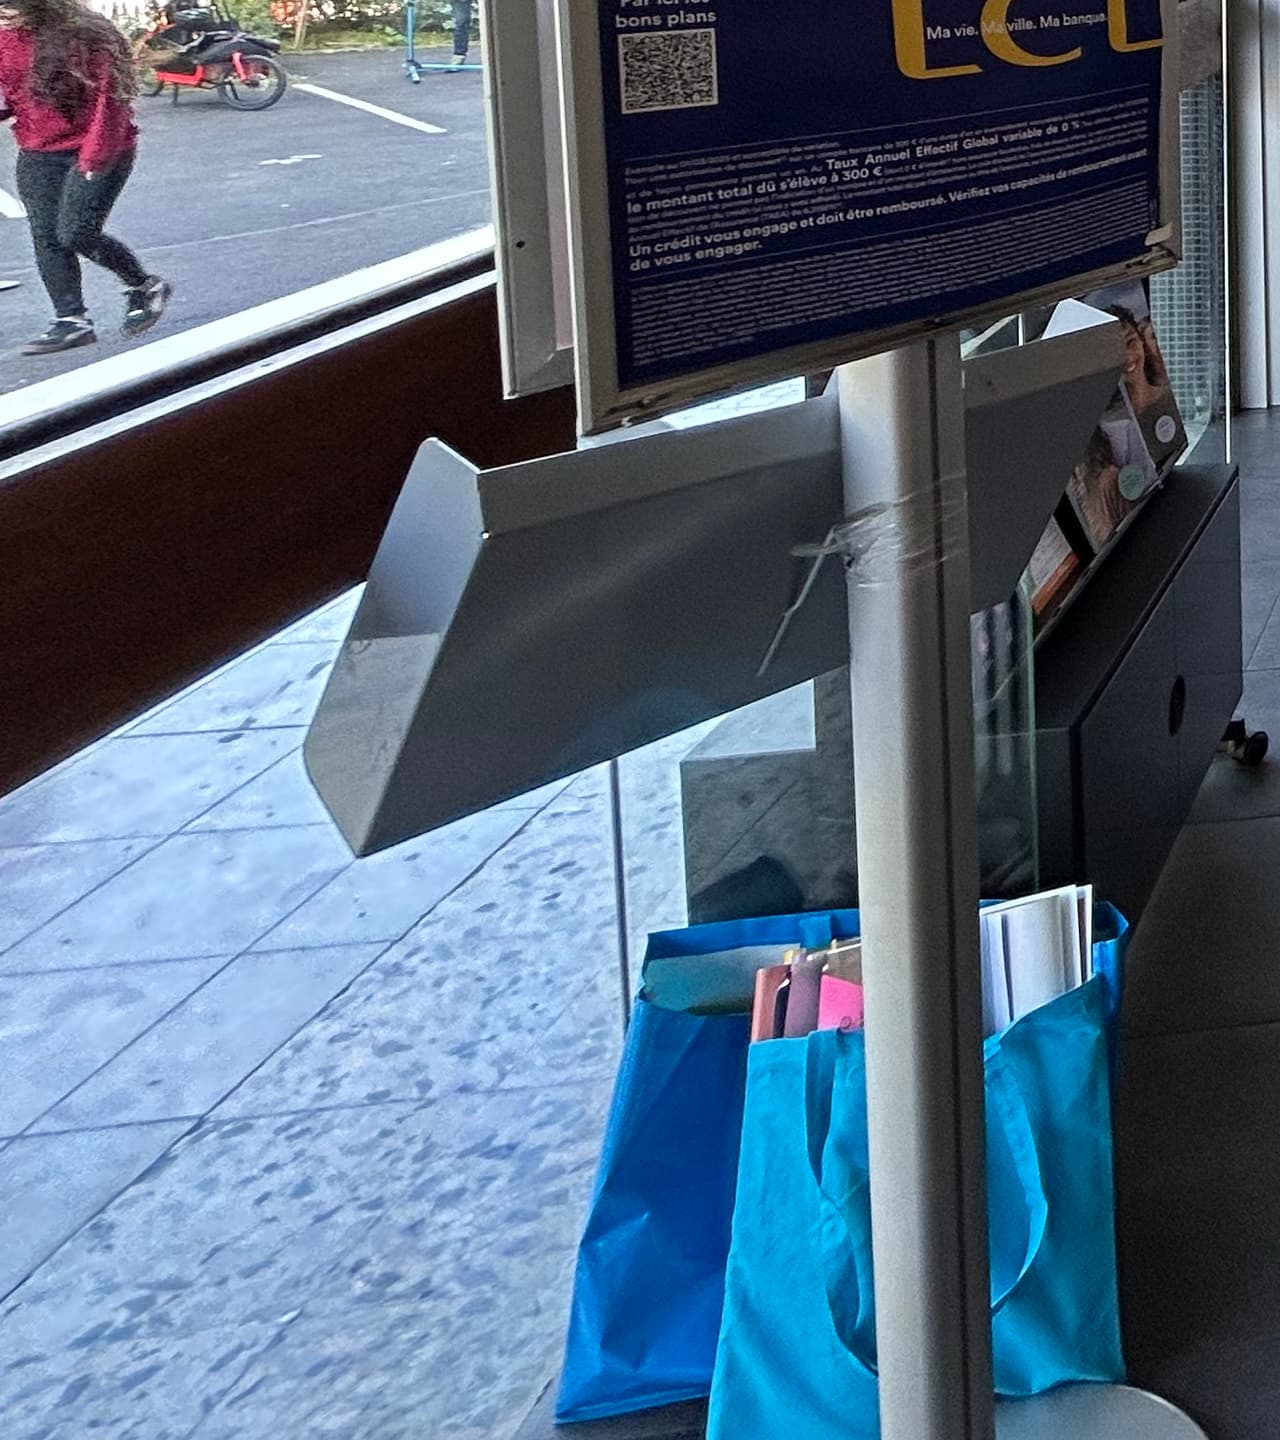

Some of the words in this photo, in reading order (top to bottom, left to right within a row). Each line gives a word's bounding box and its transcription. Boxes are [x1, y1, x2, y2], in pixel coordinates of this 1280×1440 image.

[615, 14, 662, 28] bons
[667, 10, 717, 27] plans
[926, 26, 951, 40] Ma
[954, 23, 979, 37] vie.
[1007, 17, 1038, 32] ville.
[1040, 15, 1061, 28] Ma
[1063, 12, 1108, 27] banque.
[825, 158, 859, 170] Taux
[864, 149, 911, 165] Annuel
[915, 141, 959, 157] Effectif
[962, 134, 999, 149] Global
[1046, 125, 1058, 135] de
[627, 201, 642, 214] le
[645, 192, 715, 211] montant
[717, 184, 753, 199] total
[756, 181, 776, 193] dû
[830, 172, 839, 183] à
[842, 168, 870, 180] 300
[872, 166, 883, 176] €
[629, 244, 651, 257] Un
[654, 235, 702, 252] crédit
[703, 230, 741, 243] vous
[743, 220, 798, 237] engage
[800, 216, 815, 228] et
[816, 212, 845, 225] doit
[846, 208, 874, 221] être
[629, 258, 651, 271] de
[654, 252, 692, 266] vous
[694, 240, 763, 259] engager.
